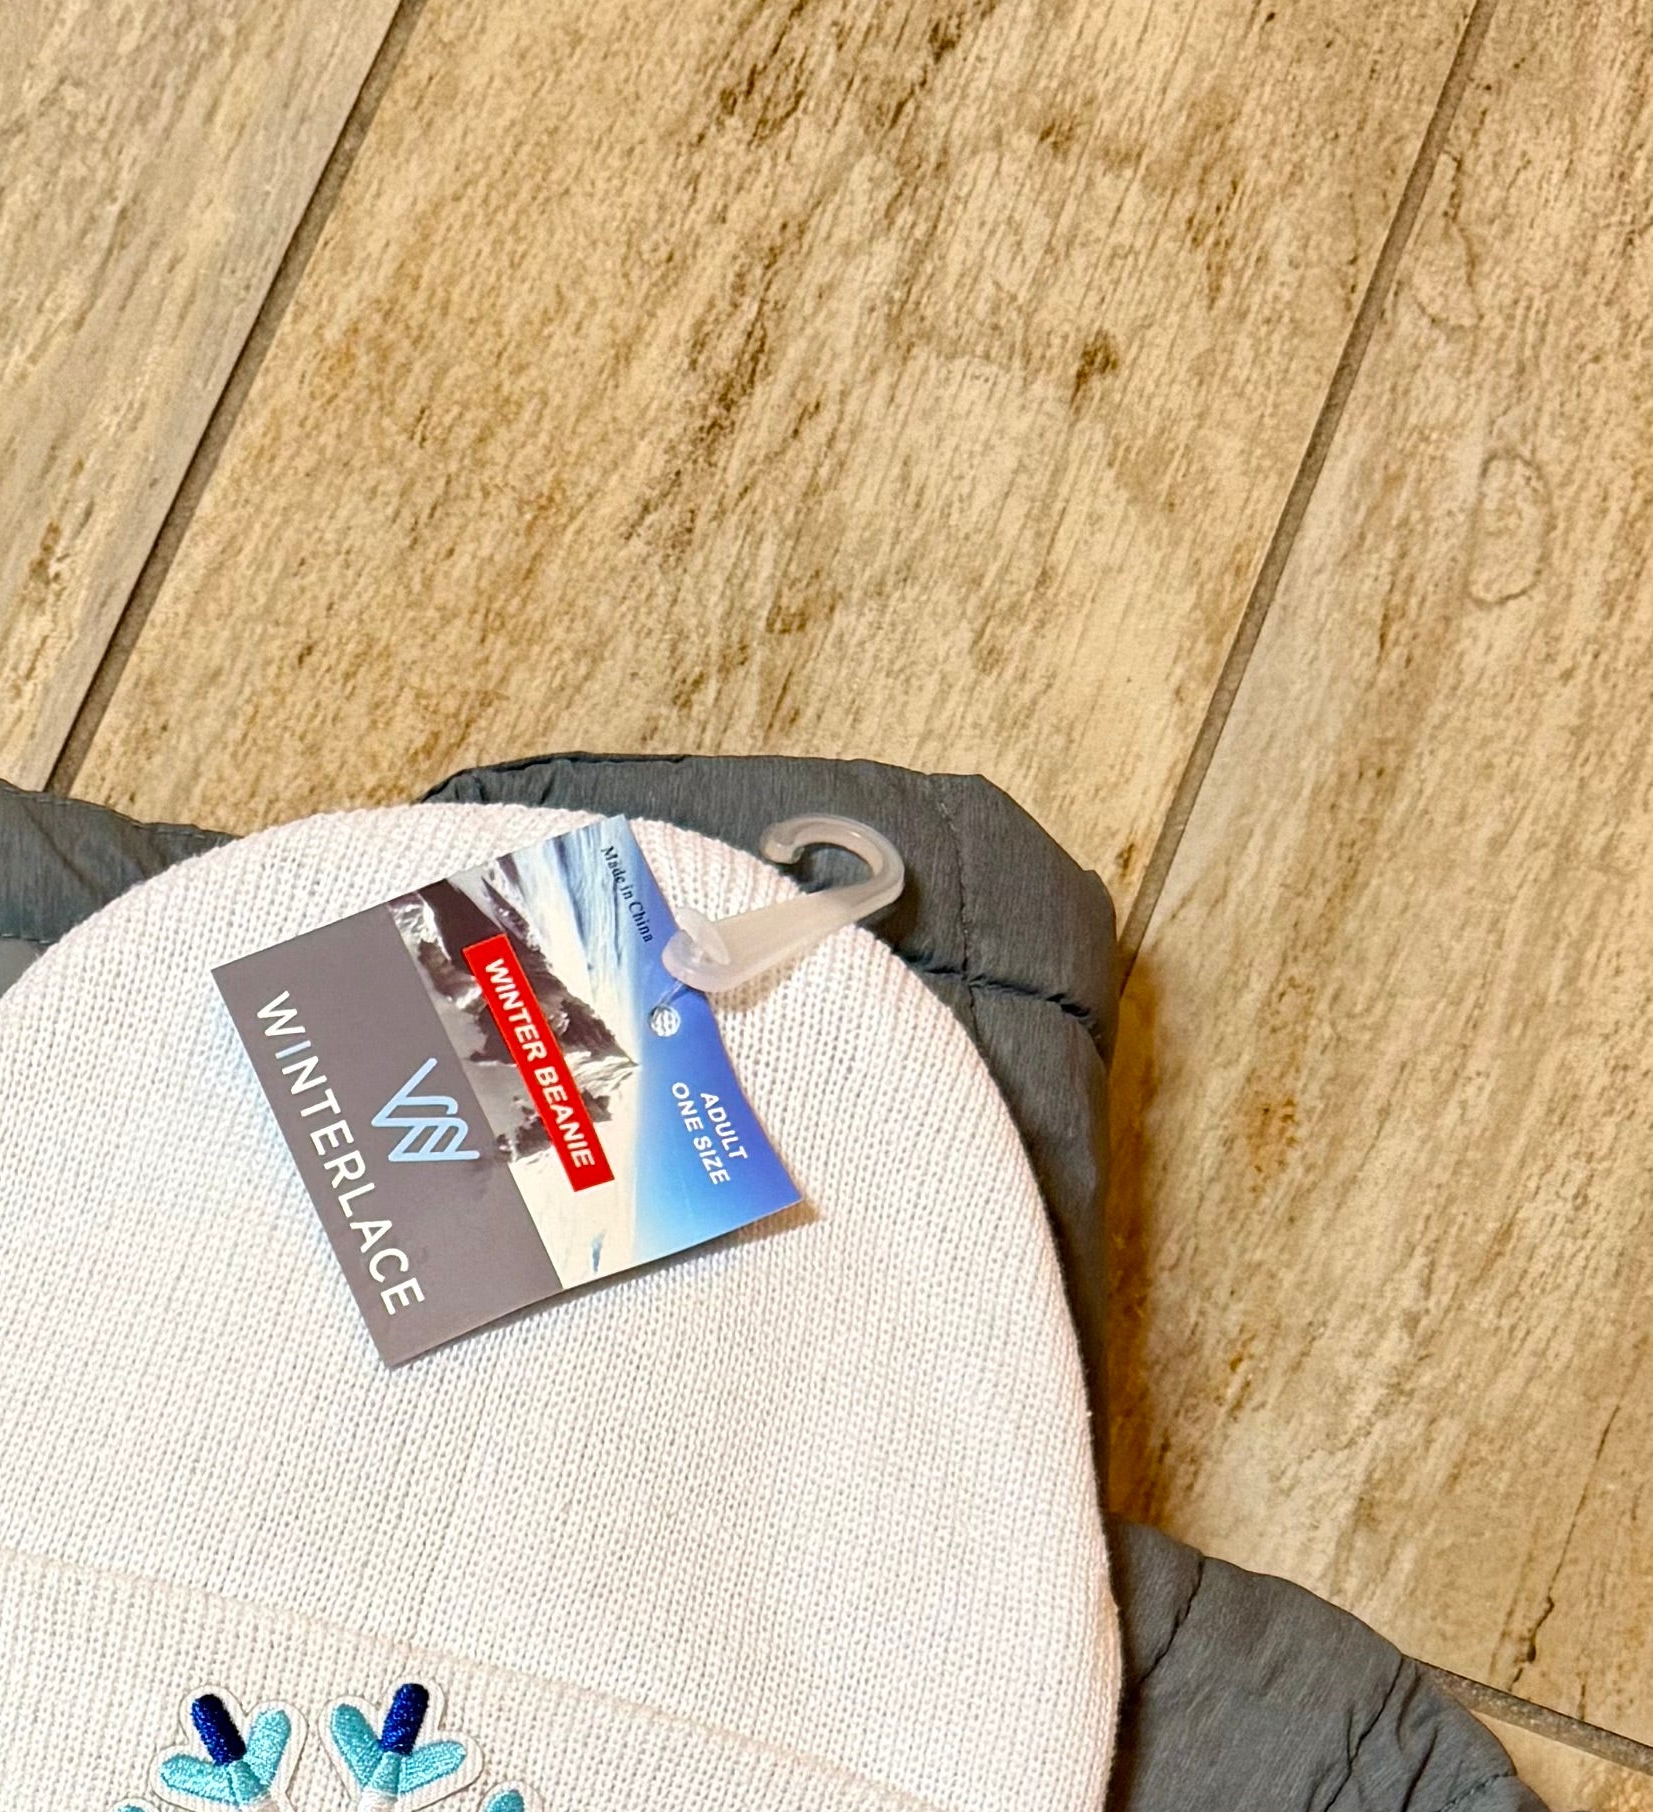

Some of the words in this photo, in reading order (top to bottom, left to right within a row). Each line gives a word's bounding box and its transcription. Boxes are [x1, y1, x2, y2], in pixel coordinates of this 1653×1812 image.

[600, 845, 626, 884] Made
[620, 884, 633, 900] in
[628, 901, 654, 942] China
[485, 958, 547, 1062] WINTER
[534, 1065, 595, 1168] BEANIE
[257, 990, 425, 1317] WINTERLACE
[671, 1081, 704, 1133] ONE
[693, 1135, 731, 1185] SIZE
[700, 1092, 748, 1160] ADULT
